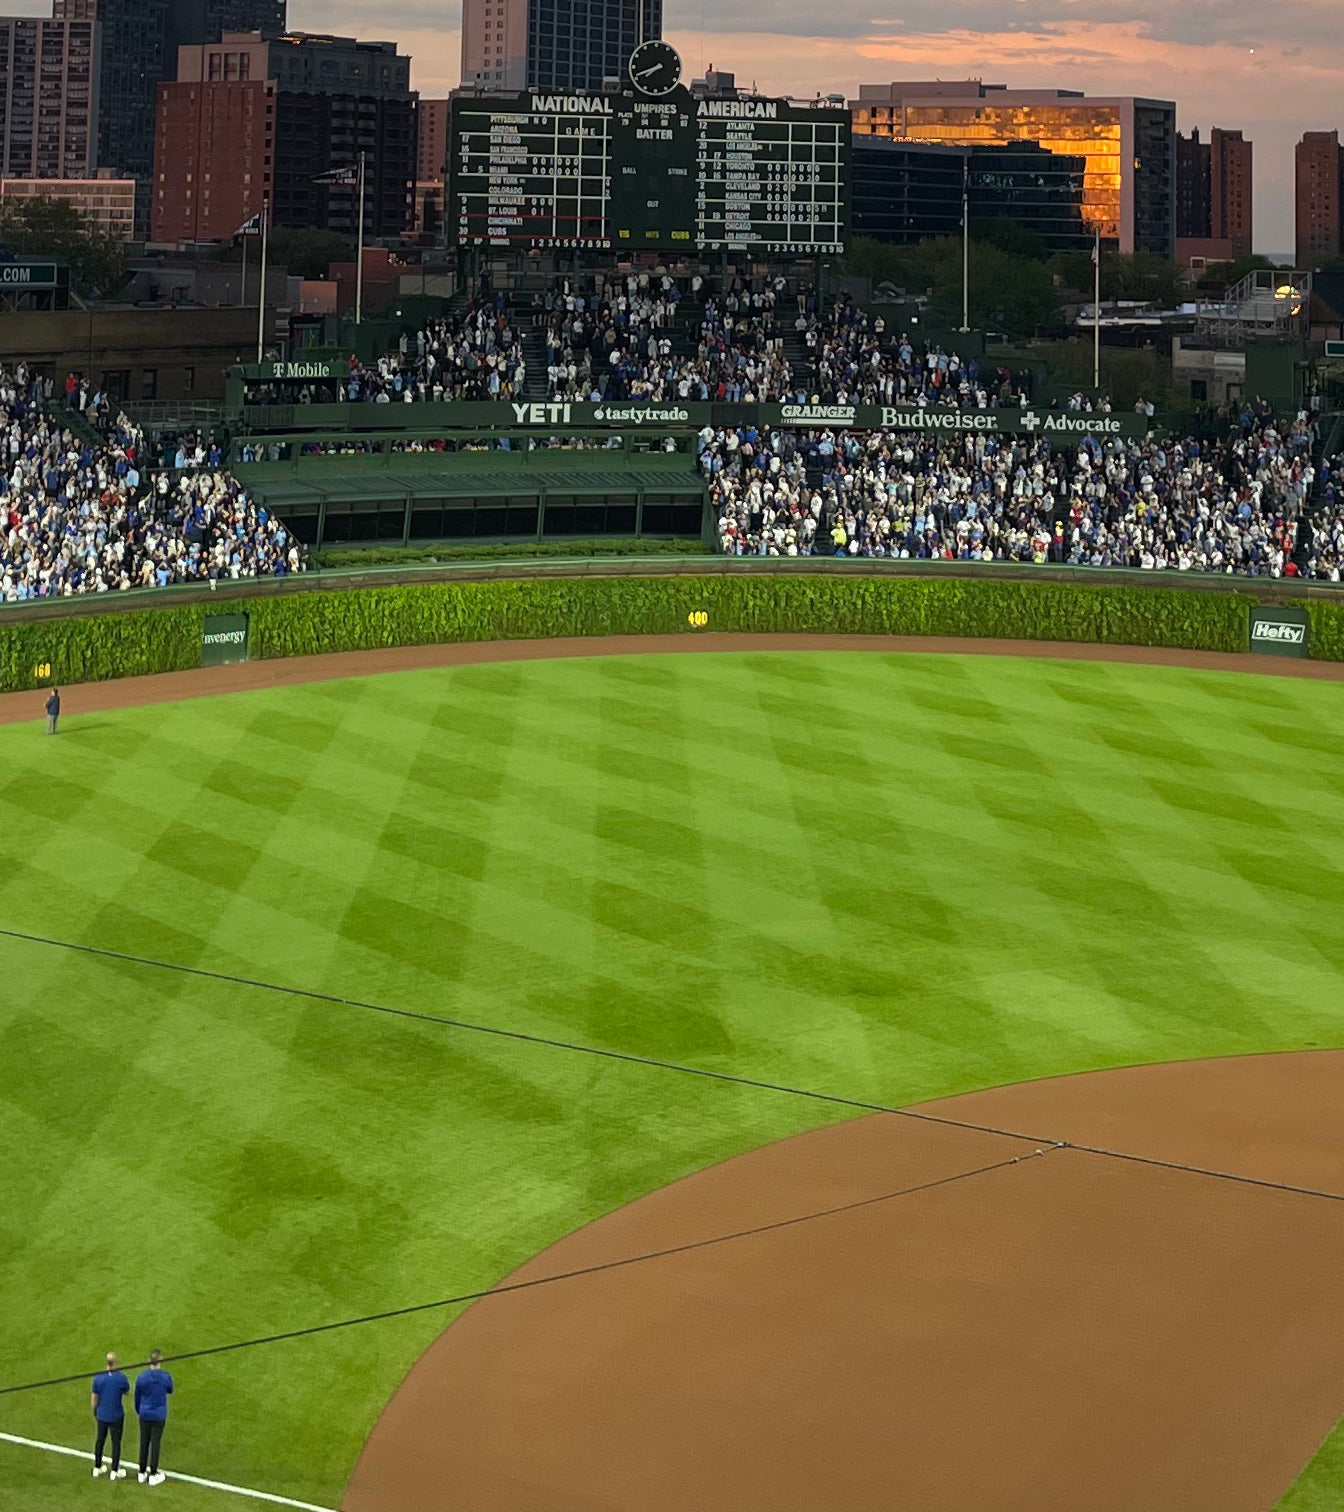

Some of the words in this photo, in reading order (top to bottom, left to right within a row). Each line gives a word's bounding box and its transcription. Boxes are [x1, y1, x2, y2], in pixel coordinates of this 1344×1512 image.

[532, 95, 613, 113] NATIONAL
[634, 103, 677, 114] UMPIRES
[697, 101, 777, 118] AMERICAN
[636, 129, 673, 139] BATTER
[489, 186, 522, 194] COLORADO
[488, 227, 506, 235] CUBS
[287, 362, 330, 378] Mobile
[512, 402, 571, 423] YETI
[606, 404, 689, 423] tastytrade
[781, 404, 856, 418] GRAINGER
[880, 406, 994, 429] Budweiser
[1043, 413, 1121, 432] Advocate
[688, 611, 708, 625] 400
[1256, 624, 1301, 641] Hefty
